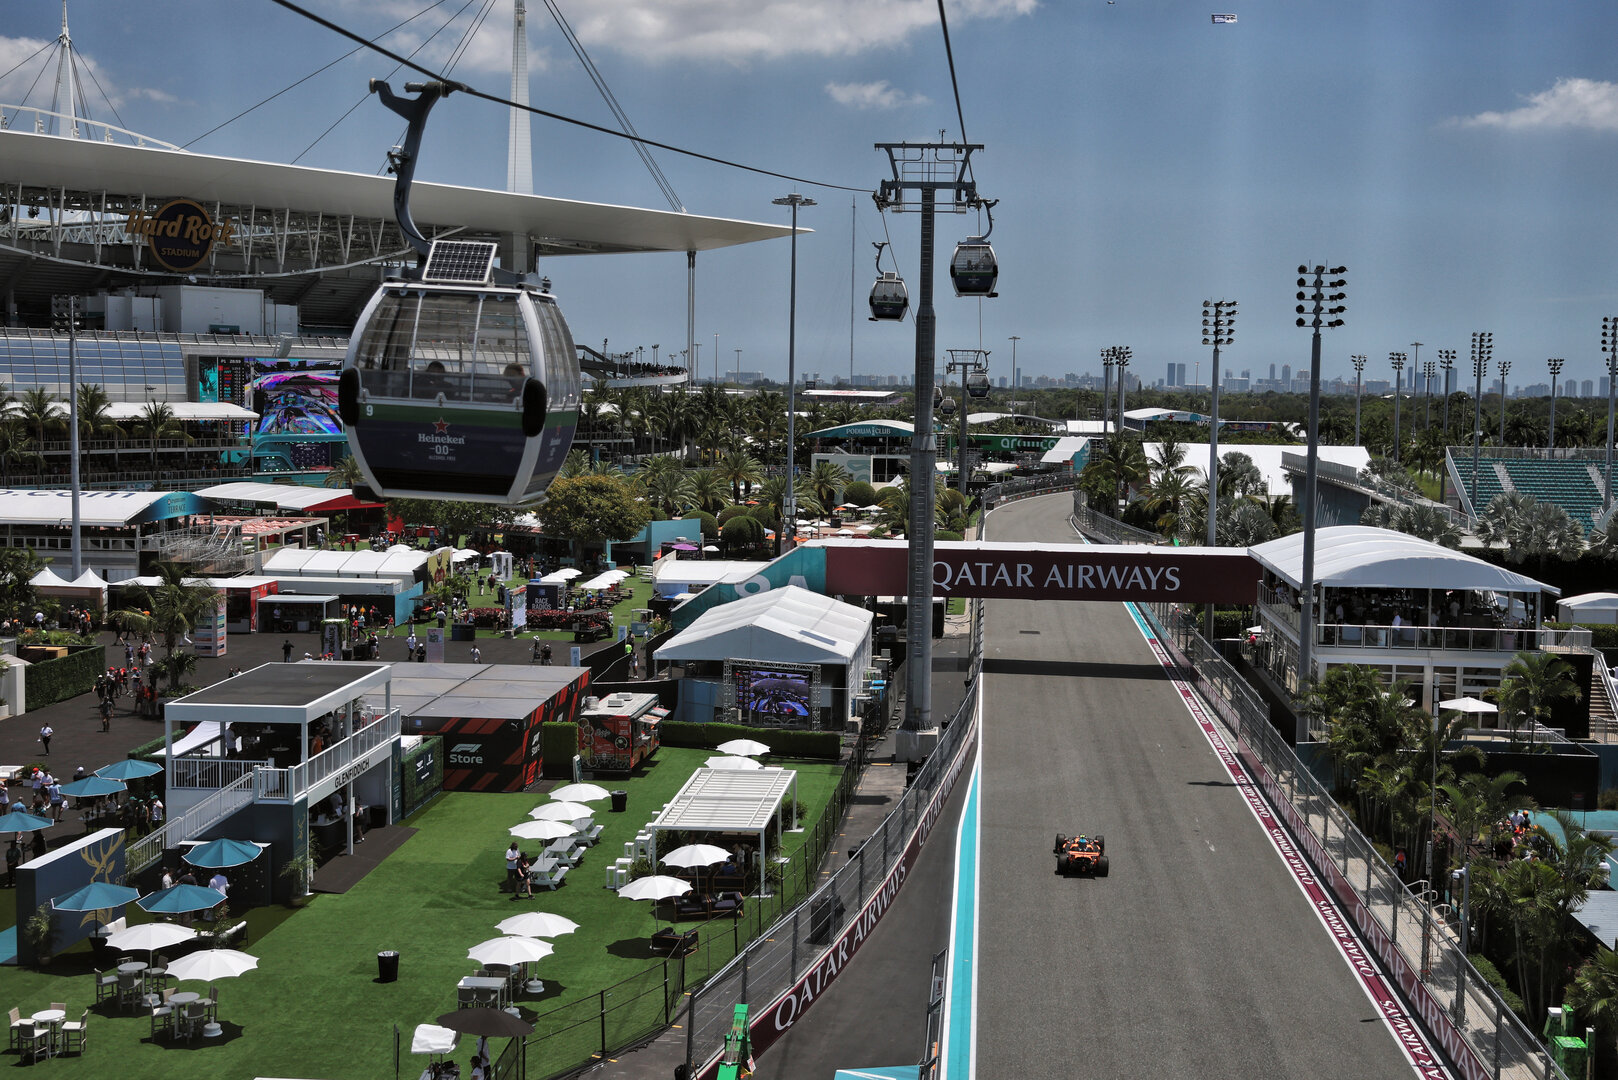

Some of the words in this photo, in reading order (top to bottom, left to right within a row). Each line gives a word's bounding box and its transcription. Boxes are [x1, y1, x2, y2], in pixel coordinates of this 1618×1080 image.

[126, 210, 184, 238] Hard
[184, 216, 234, 246] Rock
[161, 248, 200, 258] STADIUM
[366, 406, 374, 416] 9
[418, 434, 465, 444] Heineken
[1000, 438, 1056, 450] aramco
[168, 504, 186, 514] TERRACE
[932, 560, 1035, 591] QATAR
[1043, 563, 1181, 591] AIRWAYS
[334, 758, 370, 788] GLENFIDDICH
[450, 754, 484, 764] Store
[918, 791, 944, 847] QATAR
[1250, 795, 1270, 818] QATAR
[1262, 772, 1291, 825] QATAR
[1290, 813, 1335, 887] AIRWAYS
[1271, 828, 1299, 861] AIRWAYS
[1290, 857, 1314, 885] QATAR
[1316, 900, 1351, 940] AIRWAYS
[774, 944, 848, 1032] QATAR
[852, 857, 906, 950] AIRWAYS
[1342, 940, 1375, 978] QATAR
[1355, 902, 1405, 990] QATAR
[1380, 1000, 1428, 1057] AIRWAYS
